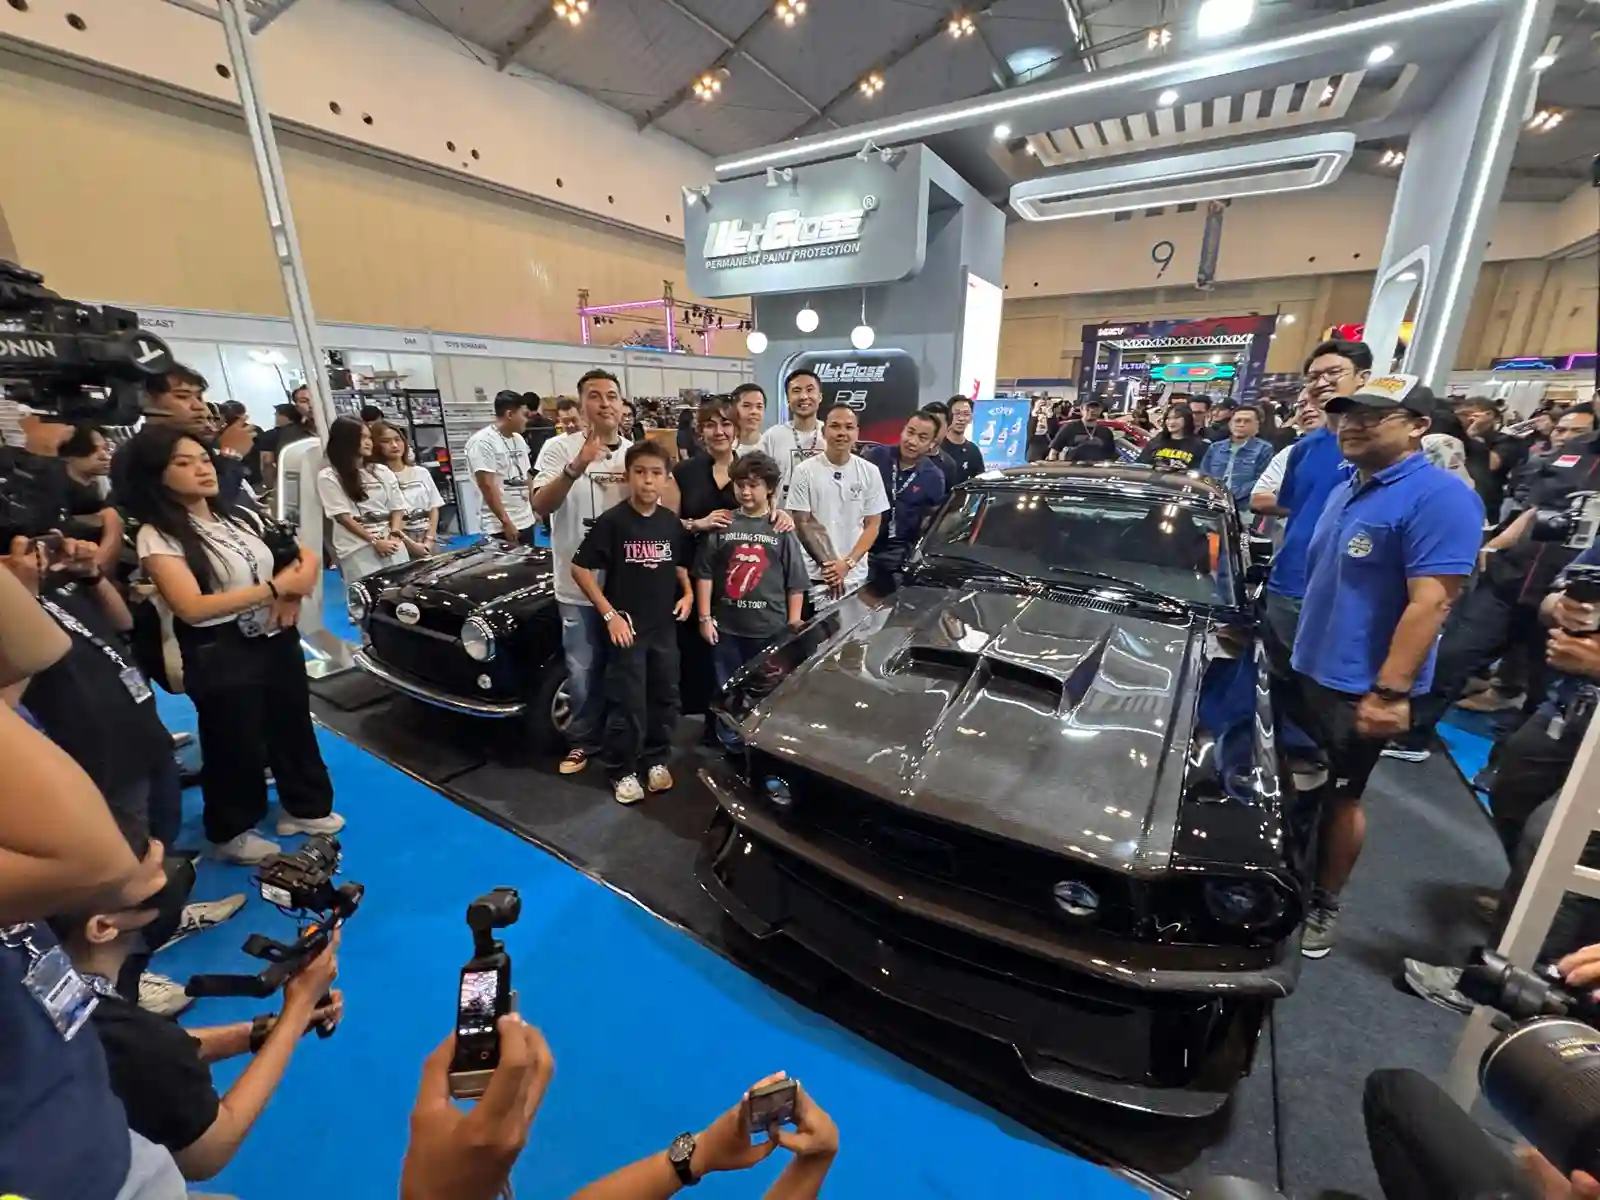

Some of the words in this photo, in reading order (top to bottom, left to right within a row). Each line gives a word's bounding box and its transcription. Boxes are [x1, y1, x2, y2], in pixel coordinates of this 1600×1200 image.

[703, 209, 865, 258] WetGloss
[706, 254, 761, 269] PERMANENT
[762, 251, 791, 265] PAINT
[793, 242, 861, 261] PROTECTION
[1152, 241, 1175, 279] 9
[725, 532, 753, 542] ROLLING
[754, 533, 779, 546] STONES
[624, 543, 656, 559] TEAM
[737, 599, 748, 608] US
[748, 600, 767, 609] TOUR
